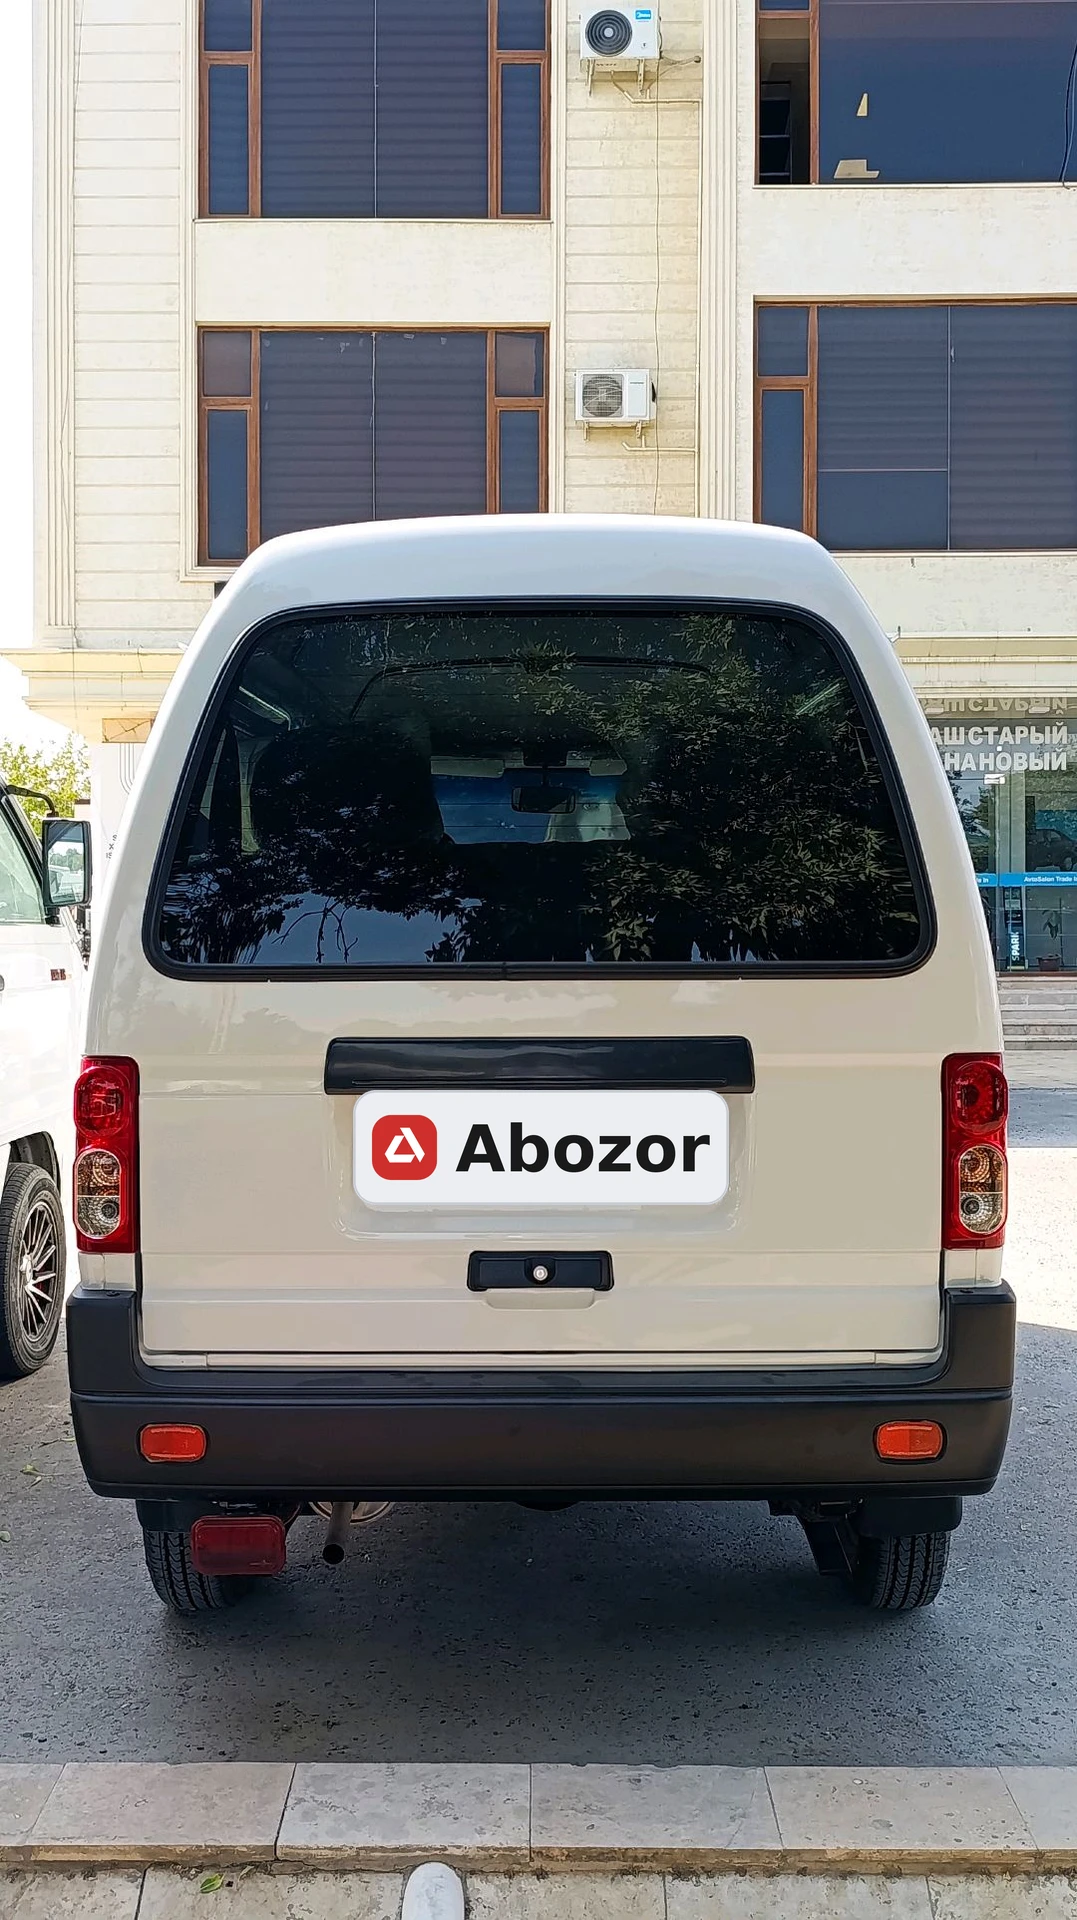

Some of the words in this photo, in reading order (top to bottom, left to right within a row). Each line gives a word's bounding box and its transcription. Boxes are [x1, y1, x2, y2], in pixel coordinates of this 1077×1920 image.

[968, 721, 1068, 745] СТАРЫЙ
[979, 747, 1067, 771] НОВЫЙ
[1010, 931, 1020, 961] SPARK
